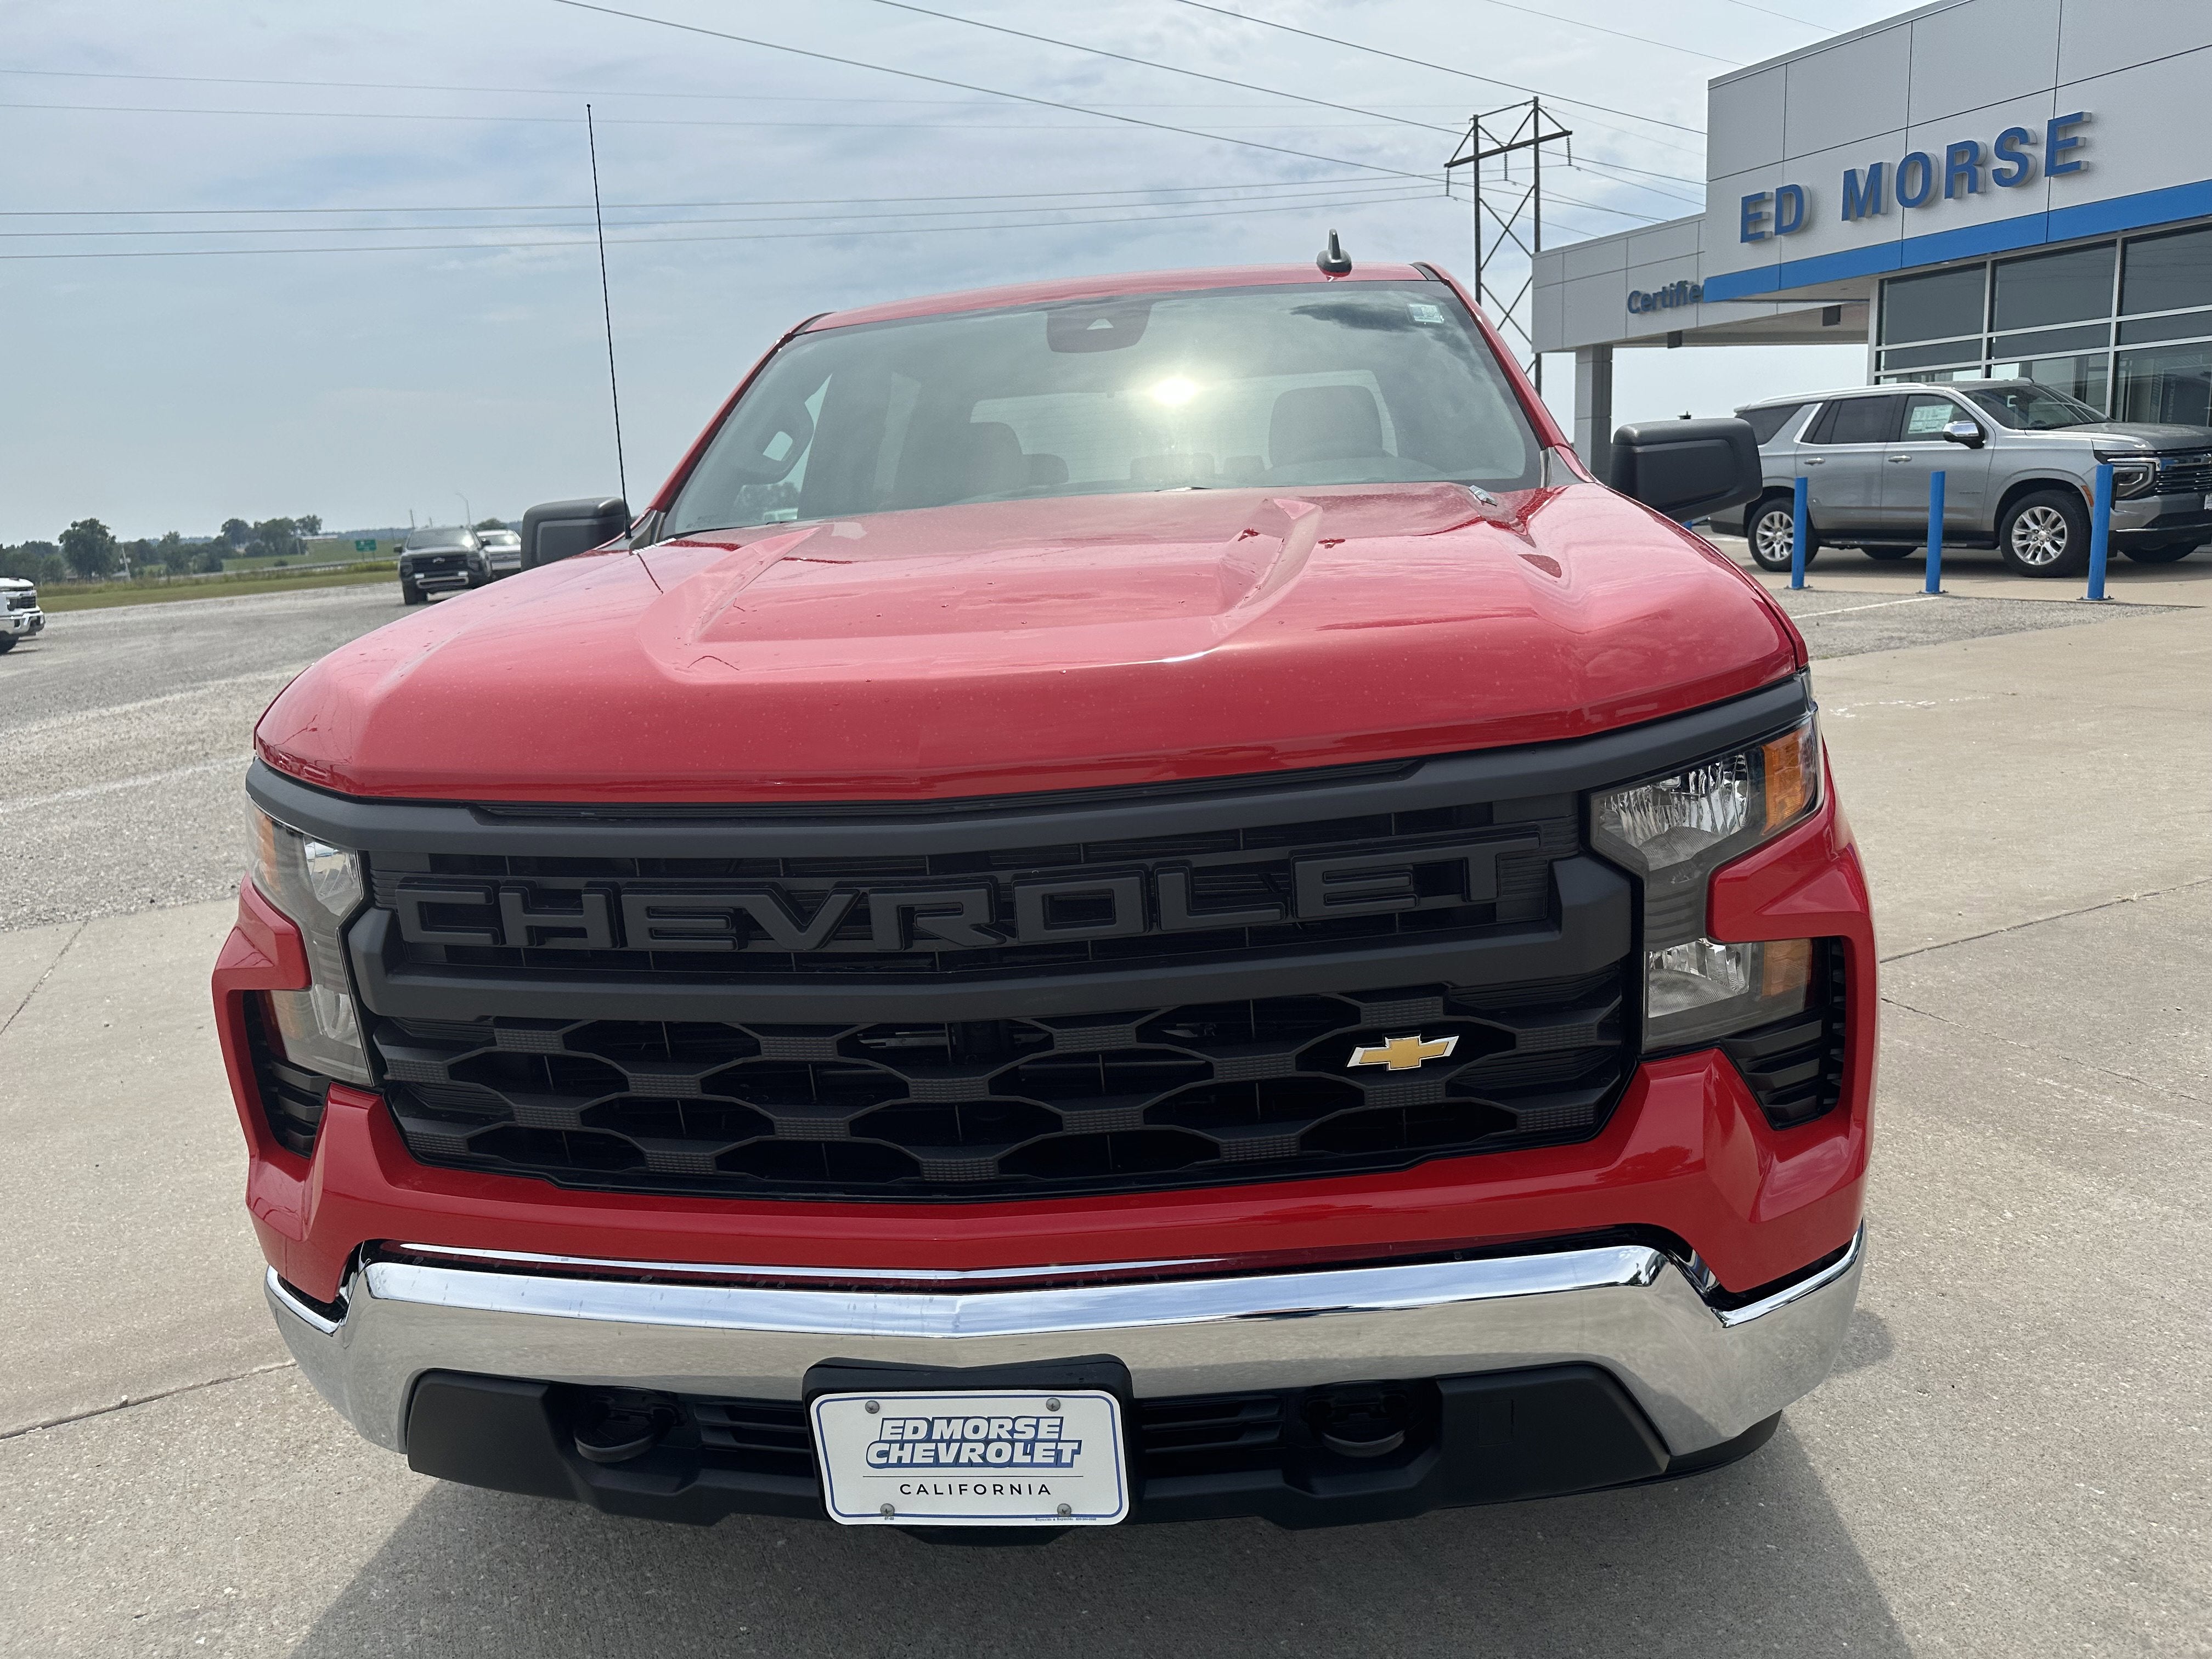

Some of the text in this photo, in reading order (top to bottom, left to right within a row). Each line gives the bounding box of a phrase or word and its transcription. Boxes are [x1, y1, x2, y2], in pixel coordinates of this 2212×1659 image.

[1740, 111, 2091, 244] ED MORSE
[1628, 280, 1704, 314] Certifie
[396, 828, 1541, 951] CHEVROLET
[880, 1417, 1064, 1441] ED MORSE
[867, 1440, 1082, 1468] CHEVROLET
[900, 1483, 1051, 1496] CALIFORNIA
